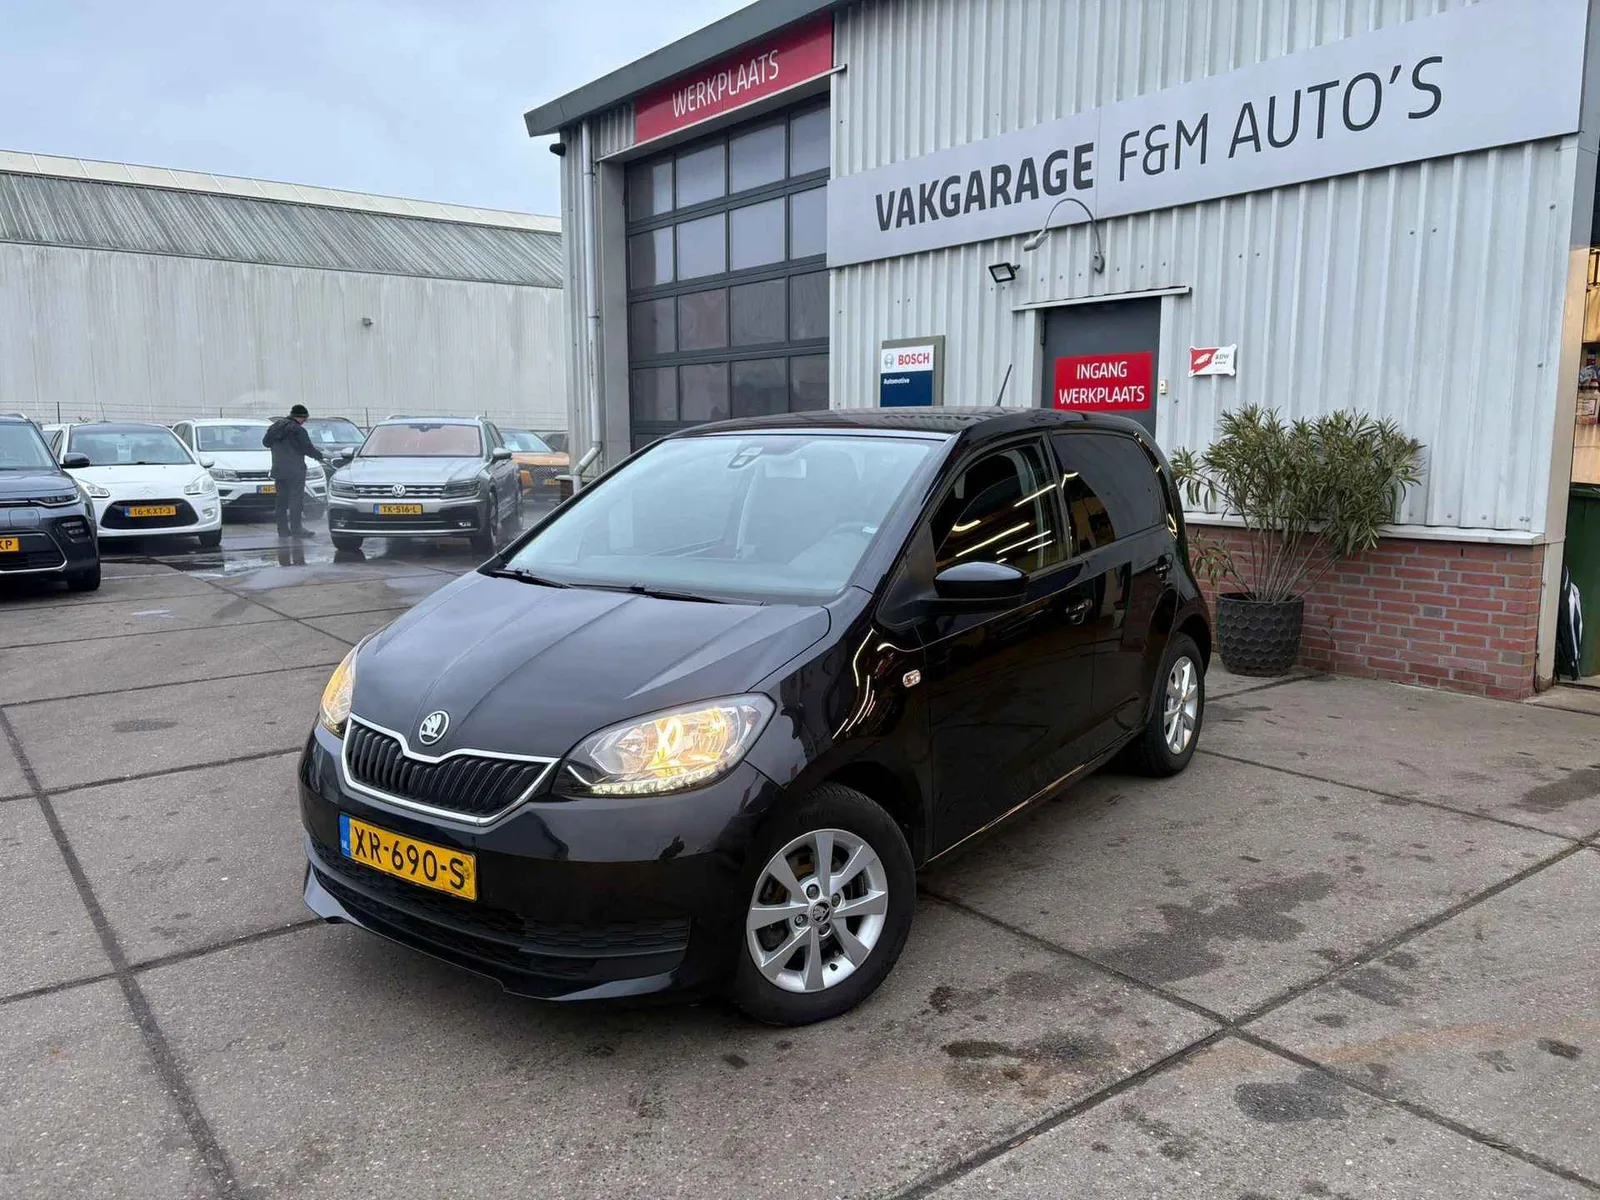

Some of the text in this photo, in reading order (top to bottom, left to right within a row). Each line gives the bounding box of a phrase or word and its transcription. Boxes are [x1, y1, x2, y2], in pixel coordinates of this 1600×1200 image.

[672, 50, 779, 118] WERKPLAATS
[875, 56, 1443, 232] VAKGARAGE F&M AUTO'S
[898, 352, 930, 365] BOSCH
[1077, 361, 1127, 380] INGANG
[1059, 385, 1145, 404] WERKPLAATS
[382, 505, 418, 513] TK-516-L
[354, 825, 465, 890] XR-690-S
